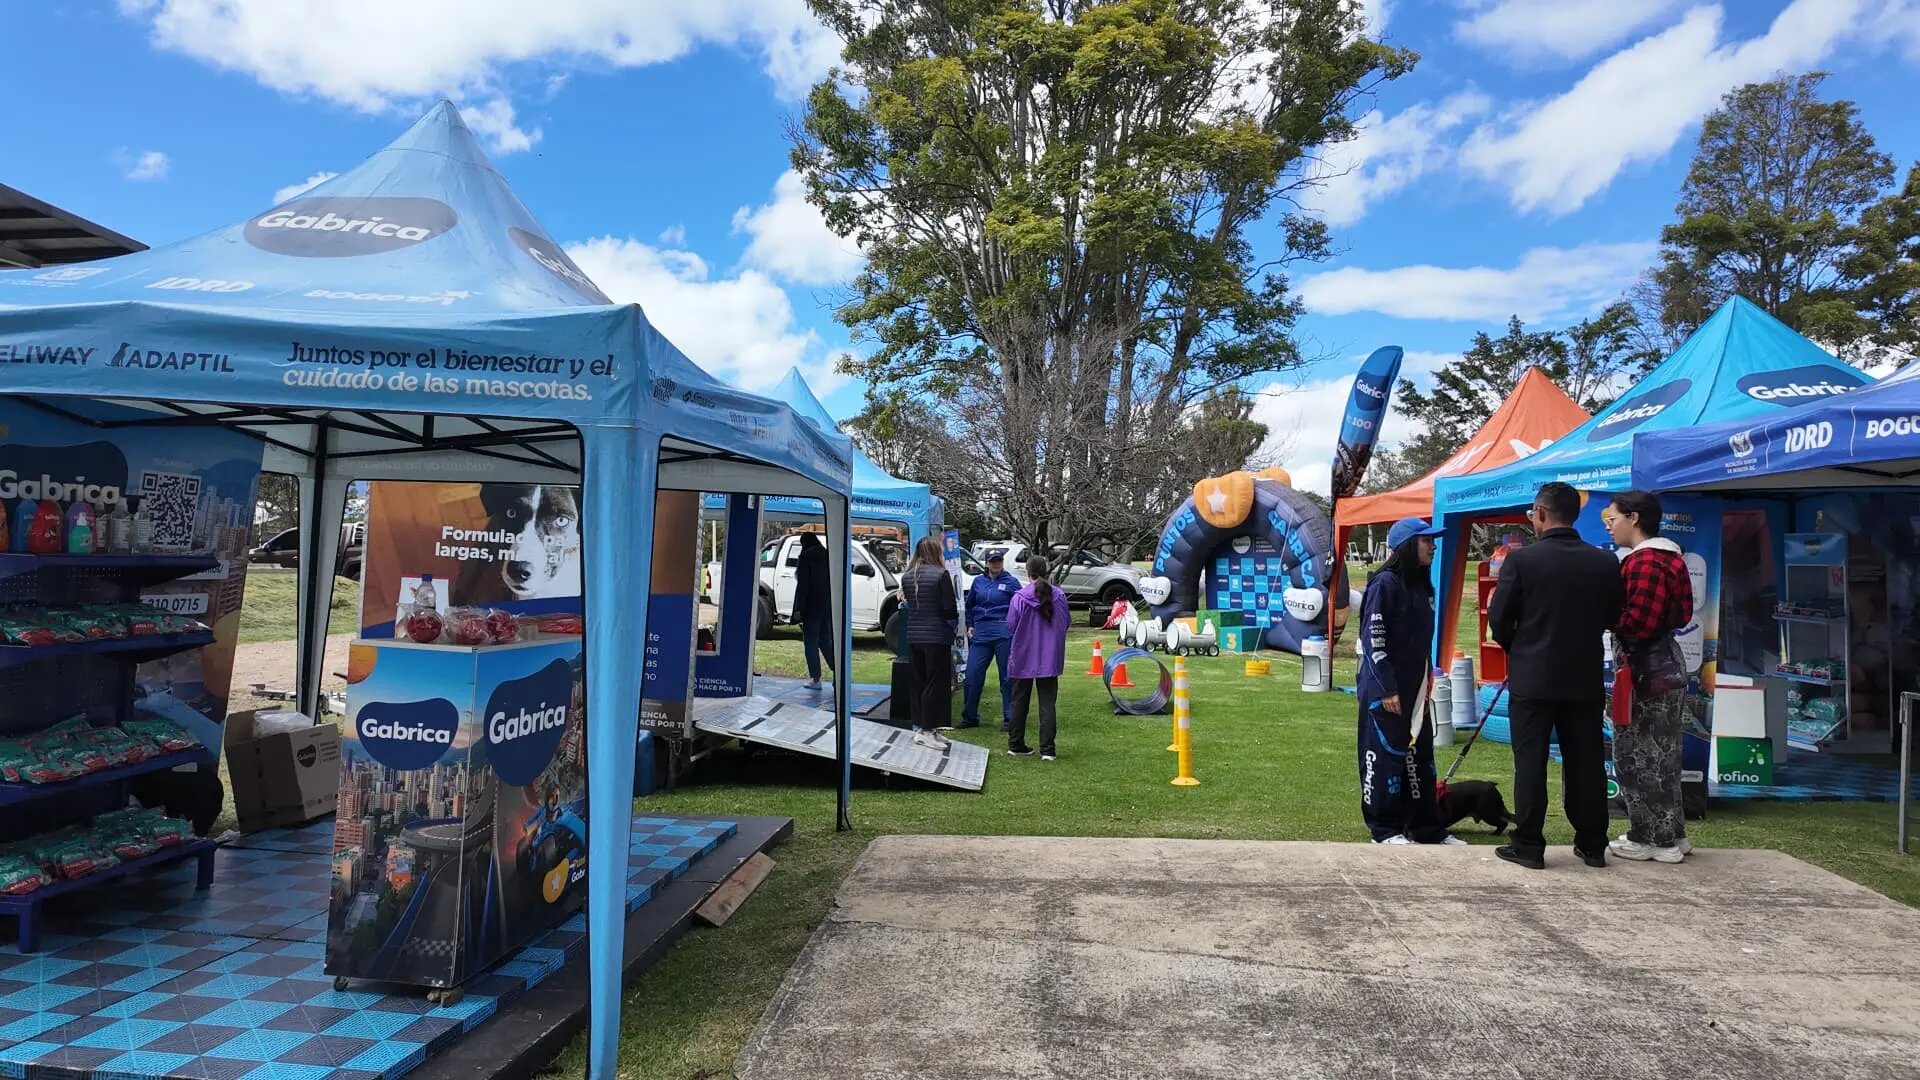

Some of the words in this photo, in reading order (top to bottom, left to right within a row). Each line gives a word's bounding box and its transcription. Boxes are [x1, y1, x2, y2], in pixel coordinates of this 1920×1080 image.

[257, 211, 431, 241] Gabrica
[146, 277, 255, 292] IDRD
[0, 345, 93, 366] ELIWAY
[125, 350, 235, 373] ADAPTIL
[287, 341, 365, 365] Juntos
[369, 350, 411, 370] por
[415, 348, 437, 368] el
[443, 349, 563, 375] bienestar
[567, 361, 585, 380] y
[590, 354, 614, 376] el
[282, 366, 383, 390] cuidado
[387, 370, 418, 392] de
[424, 373, 459, 393] las
[464, 376, 593, 401] mascotas.
[1748, 381, 1856, 400] Gabri
[1352, 416, 1373, 430] 100
[1598, 402, 1666, 428] Gabrica
[1785, 421, 1833, 454] IDRD
[1600, 464, 1632, 477] bienesta
[0, 469, 121, 505] Gabrica
[866, 497, 904, 507] bienestar
[1659, 521, 1696, 533] Gabrica
[1155, 507, 1196, 573] PUNTOS
[435, 542, 494, 562] largas,
[171, 598, 200, 611] 0715
[1226, 632, 1237, 649] 3
[361, 718, 450, 744] Gabrica
[489, 702, 567, 744] Gabrica
[657, 720, 675, 729] POR
[1364, 751, 1377, 805] Gabrica
[1718, 770, 1760, 783] rofino
